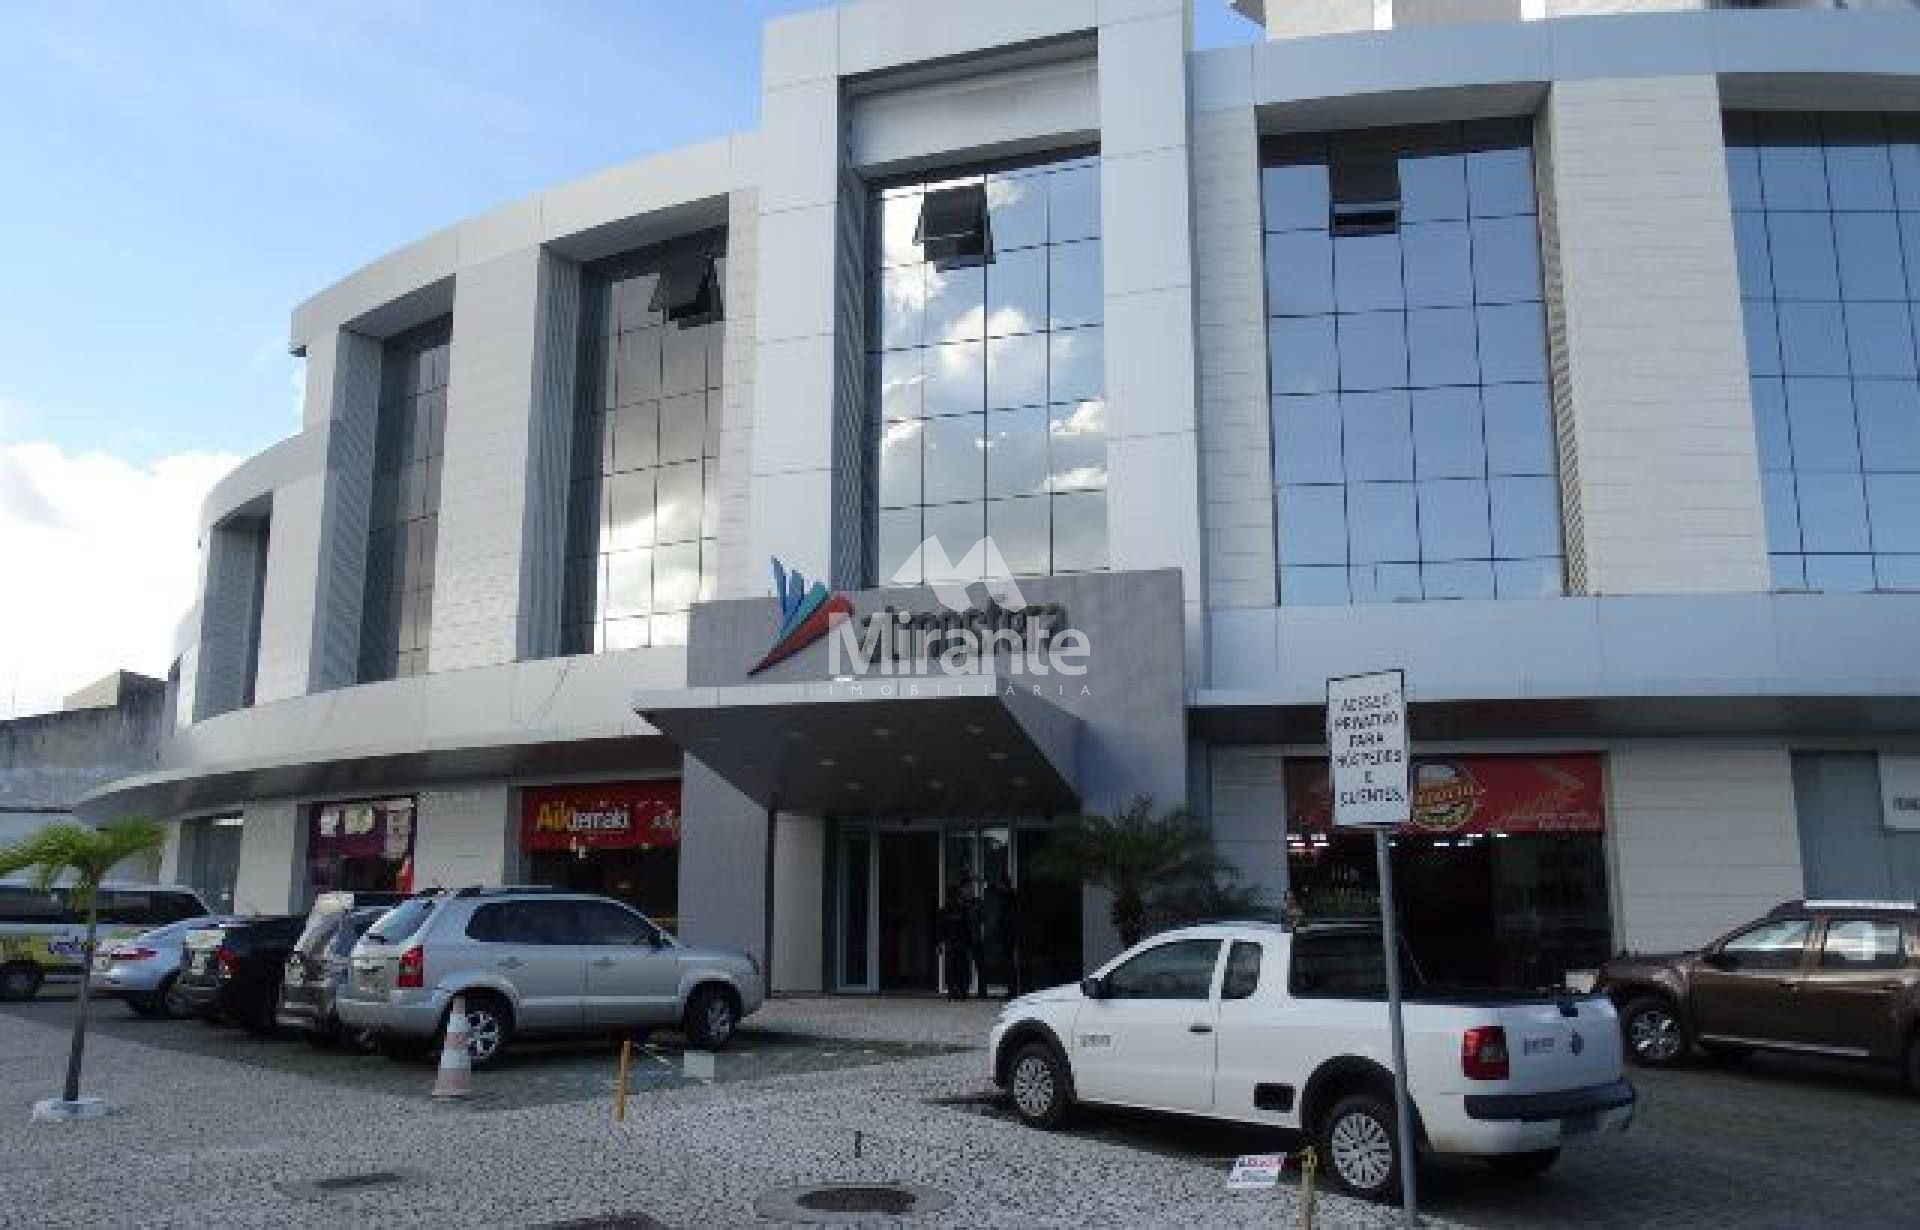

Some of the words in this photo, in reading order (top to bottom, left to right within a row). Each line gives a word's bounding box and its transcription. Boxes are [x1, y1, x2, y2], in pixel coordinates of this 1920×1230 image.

[1334, 710, 1399, 731] PRIVATIVO
[1349, 732, 1384, 748] PARA
[1364, 770, 1374, 784] E
